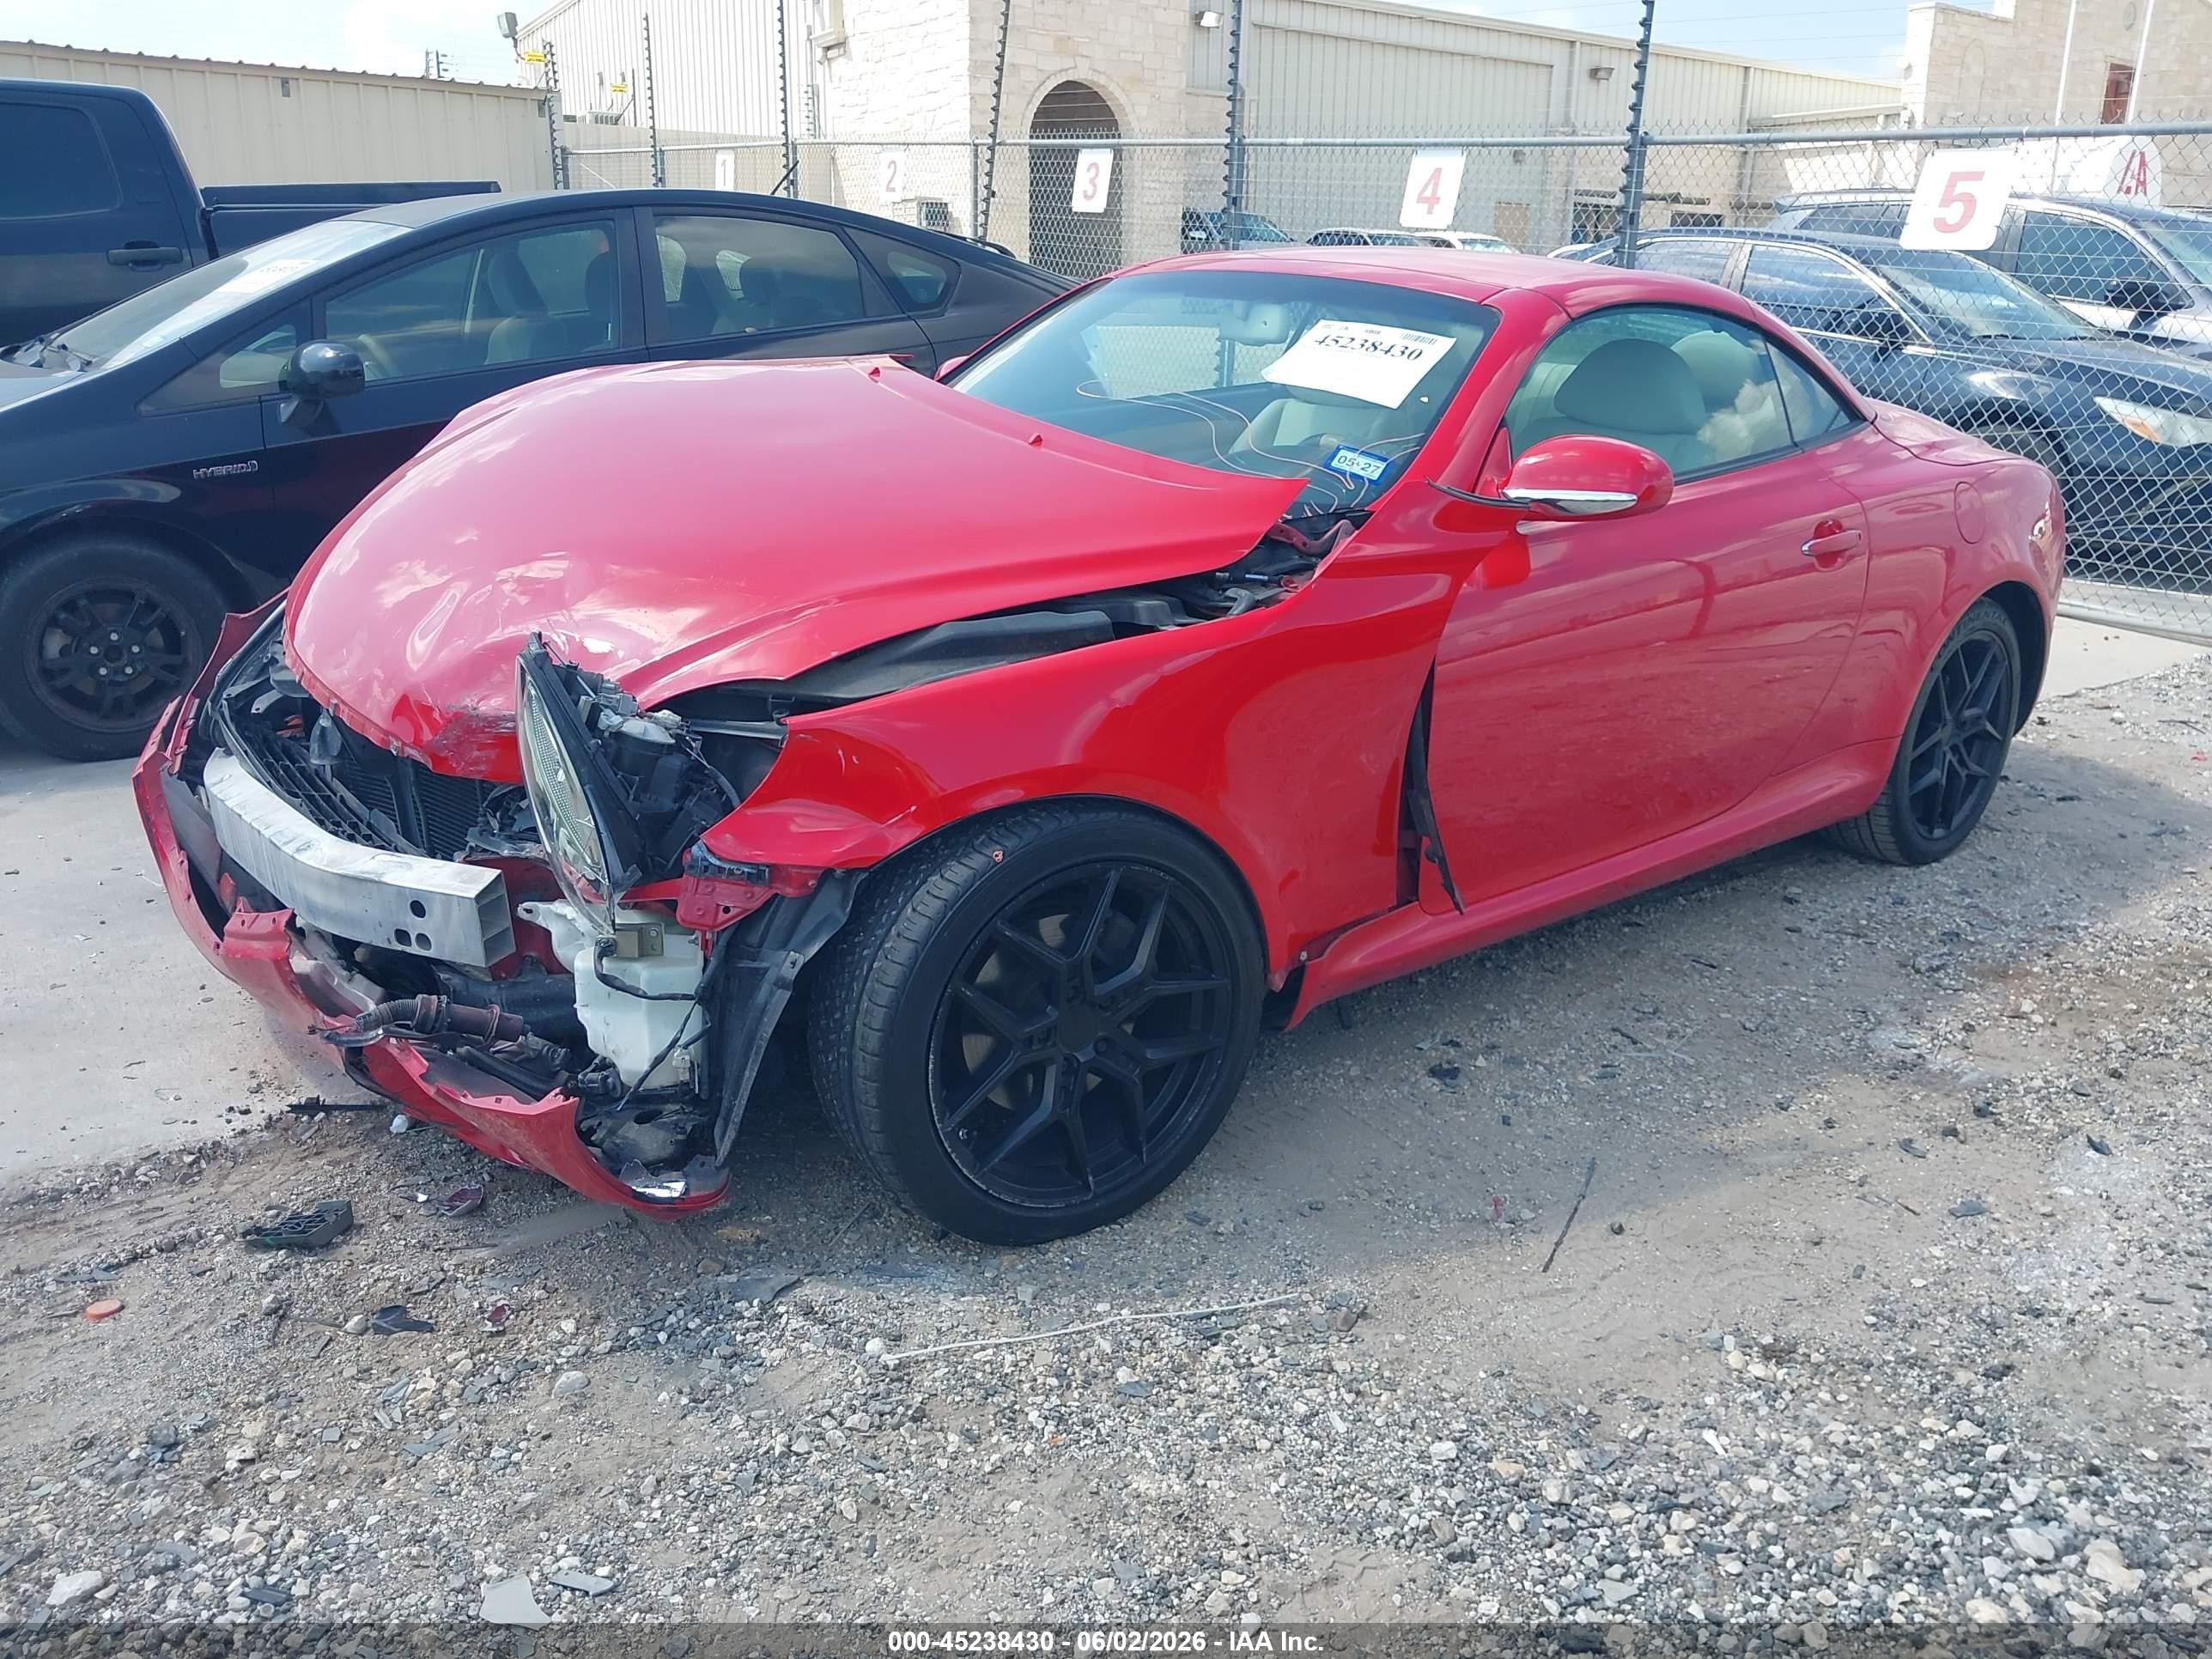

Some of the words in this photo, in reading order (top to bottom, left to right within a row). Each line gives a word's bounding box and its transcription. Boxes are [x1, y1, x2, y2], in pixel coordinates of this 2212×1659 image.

[721, 158, 727, 187] 1
[884, 159, 897, 193] 2
[1083, 161, 1100, 201] 3
[1415, 167, 1443, 216] 4
[1933, 170, 1986, 234] 5
[1314, 334, 1424, 362] 45238430
[192, 463, 249, 480] HYBRID
[1337, 454, 1357, 467] 05
[1360, 462, 1382, 474] 27
